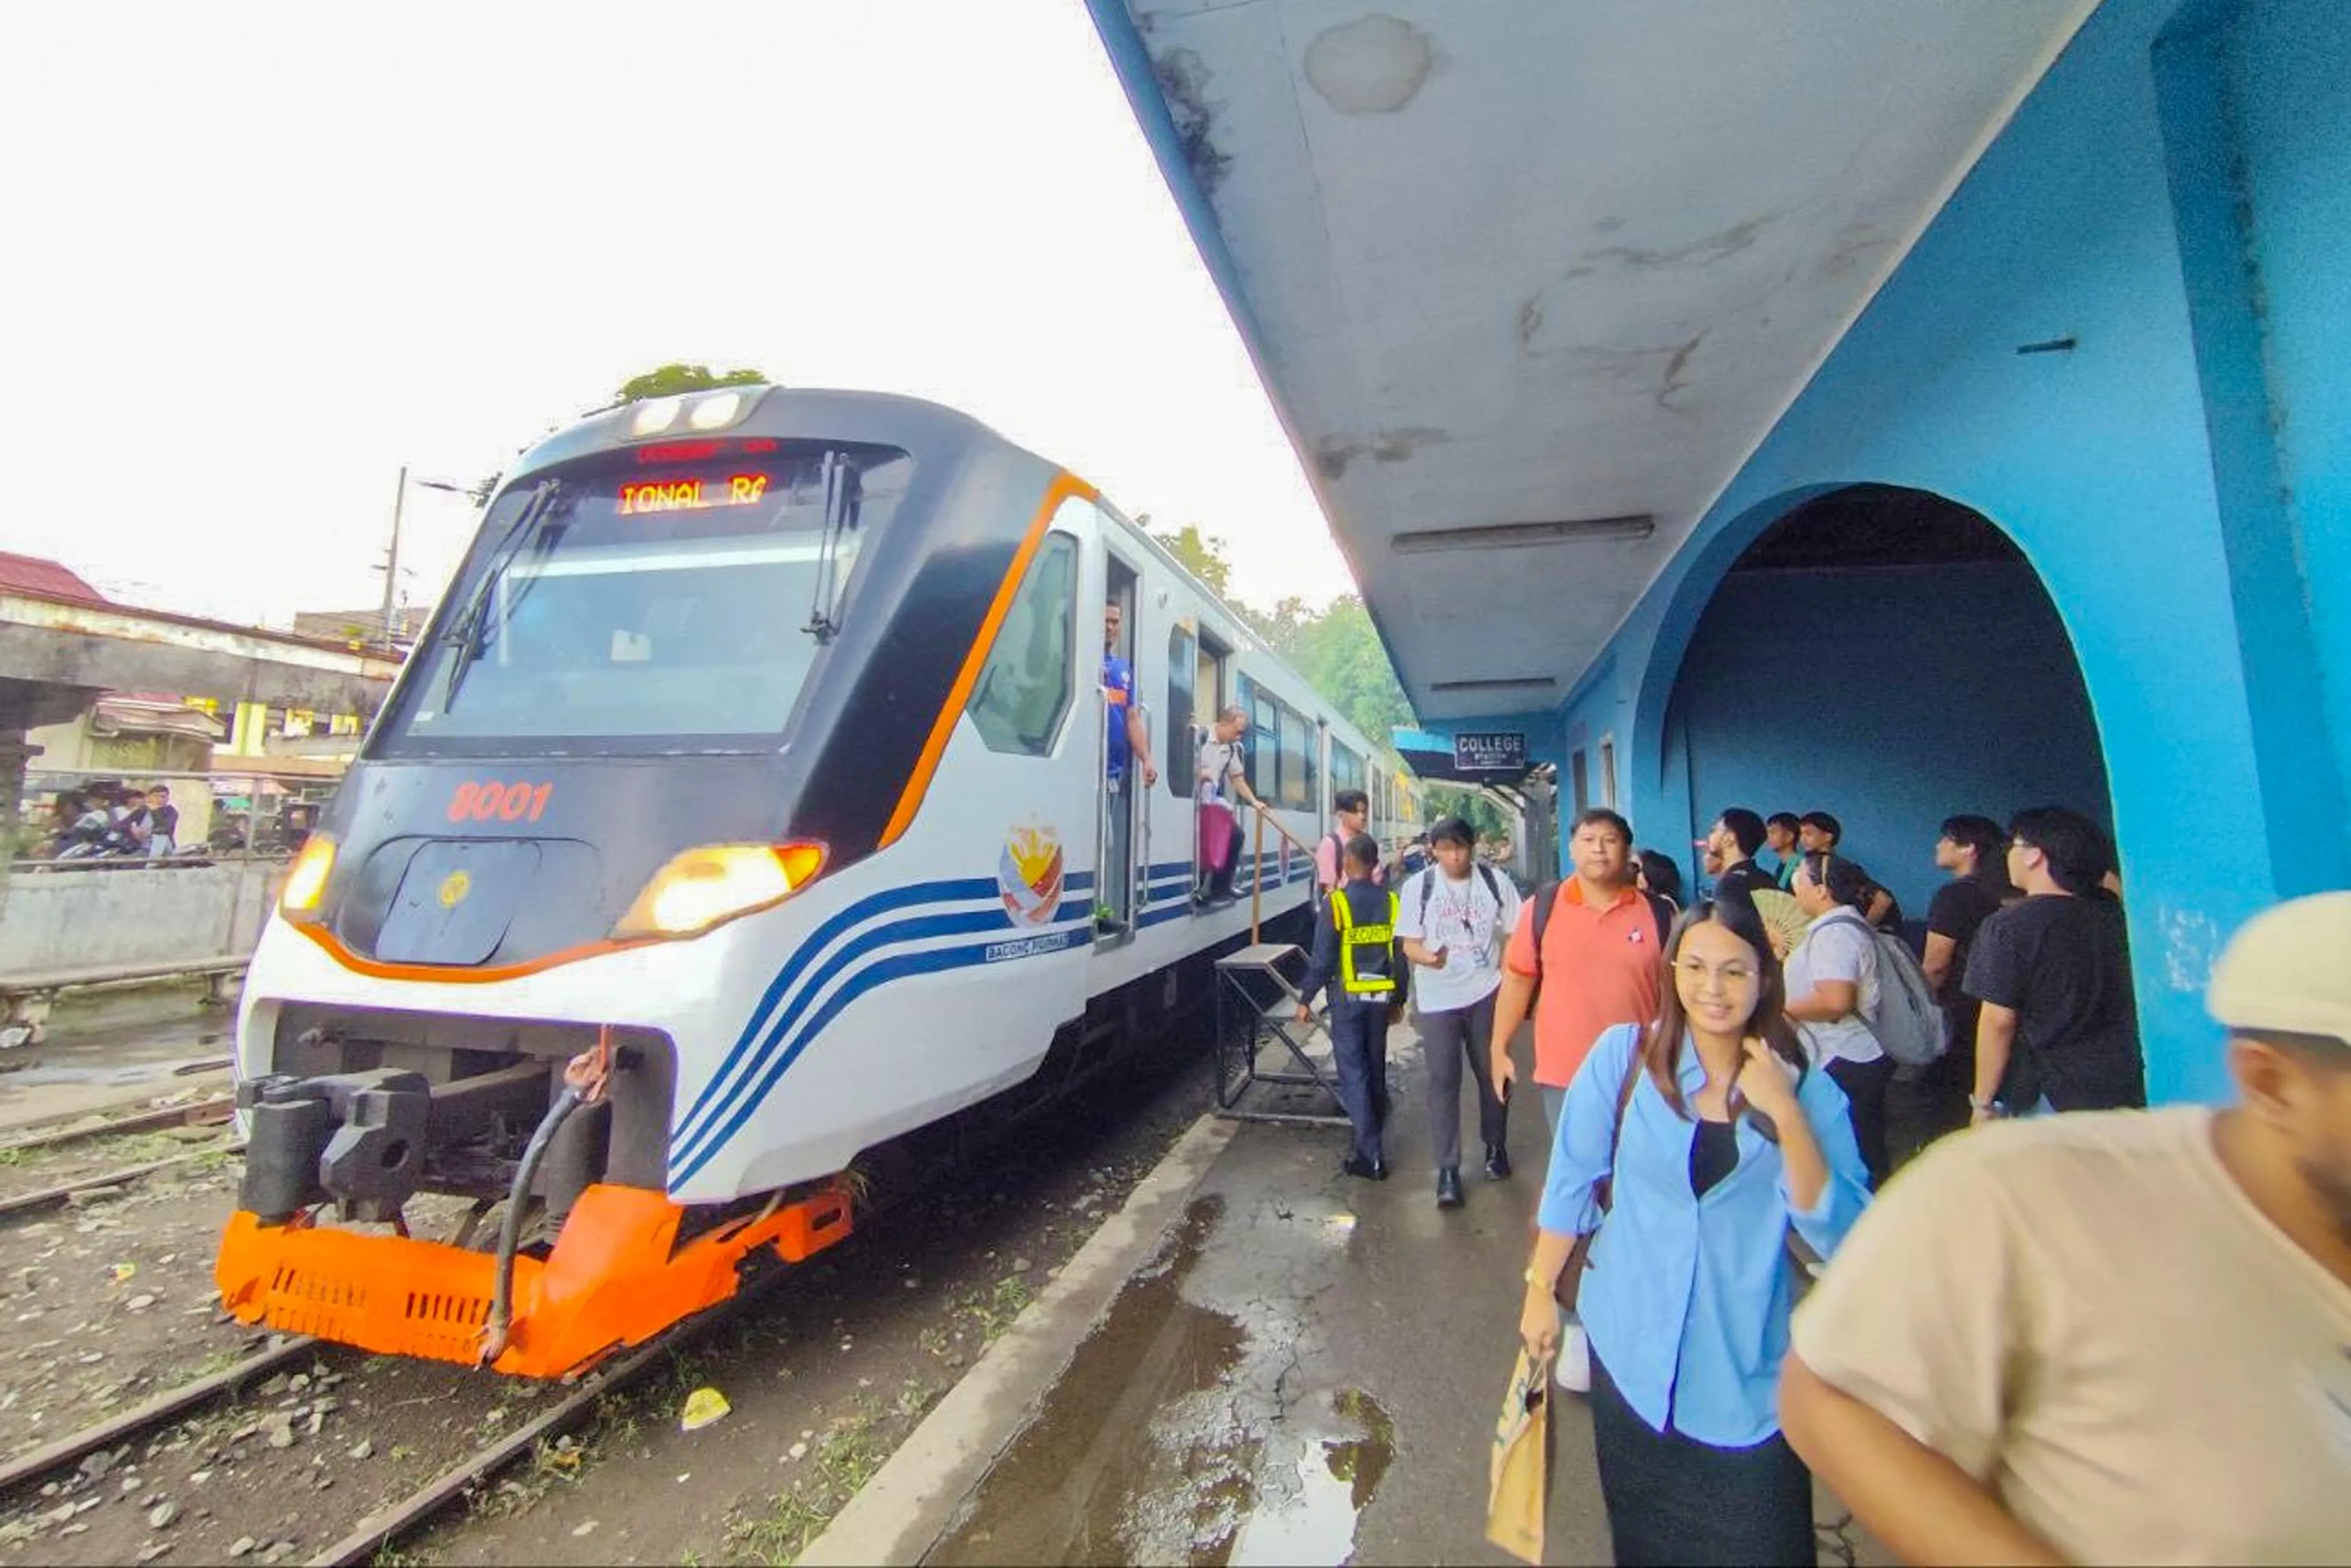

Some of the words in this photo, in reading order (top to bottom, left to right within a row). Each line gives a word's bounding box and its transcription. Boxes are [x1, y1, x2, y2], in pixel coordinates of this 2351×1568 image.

[621, 481, 712, 514] IONAL
[1460, 737, 1521, 752] COLLEGE
[447, 781, 553, 822] 8001
[1348, 926, 1393, 942] SECURIT
